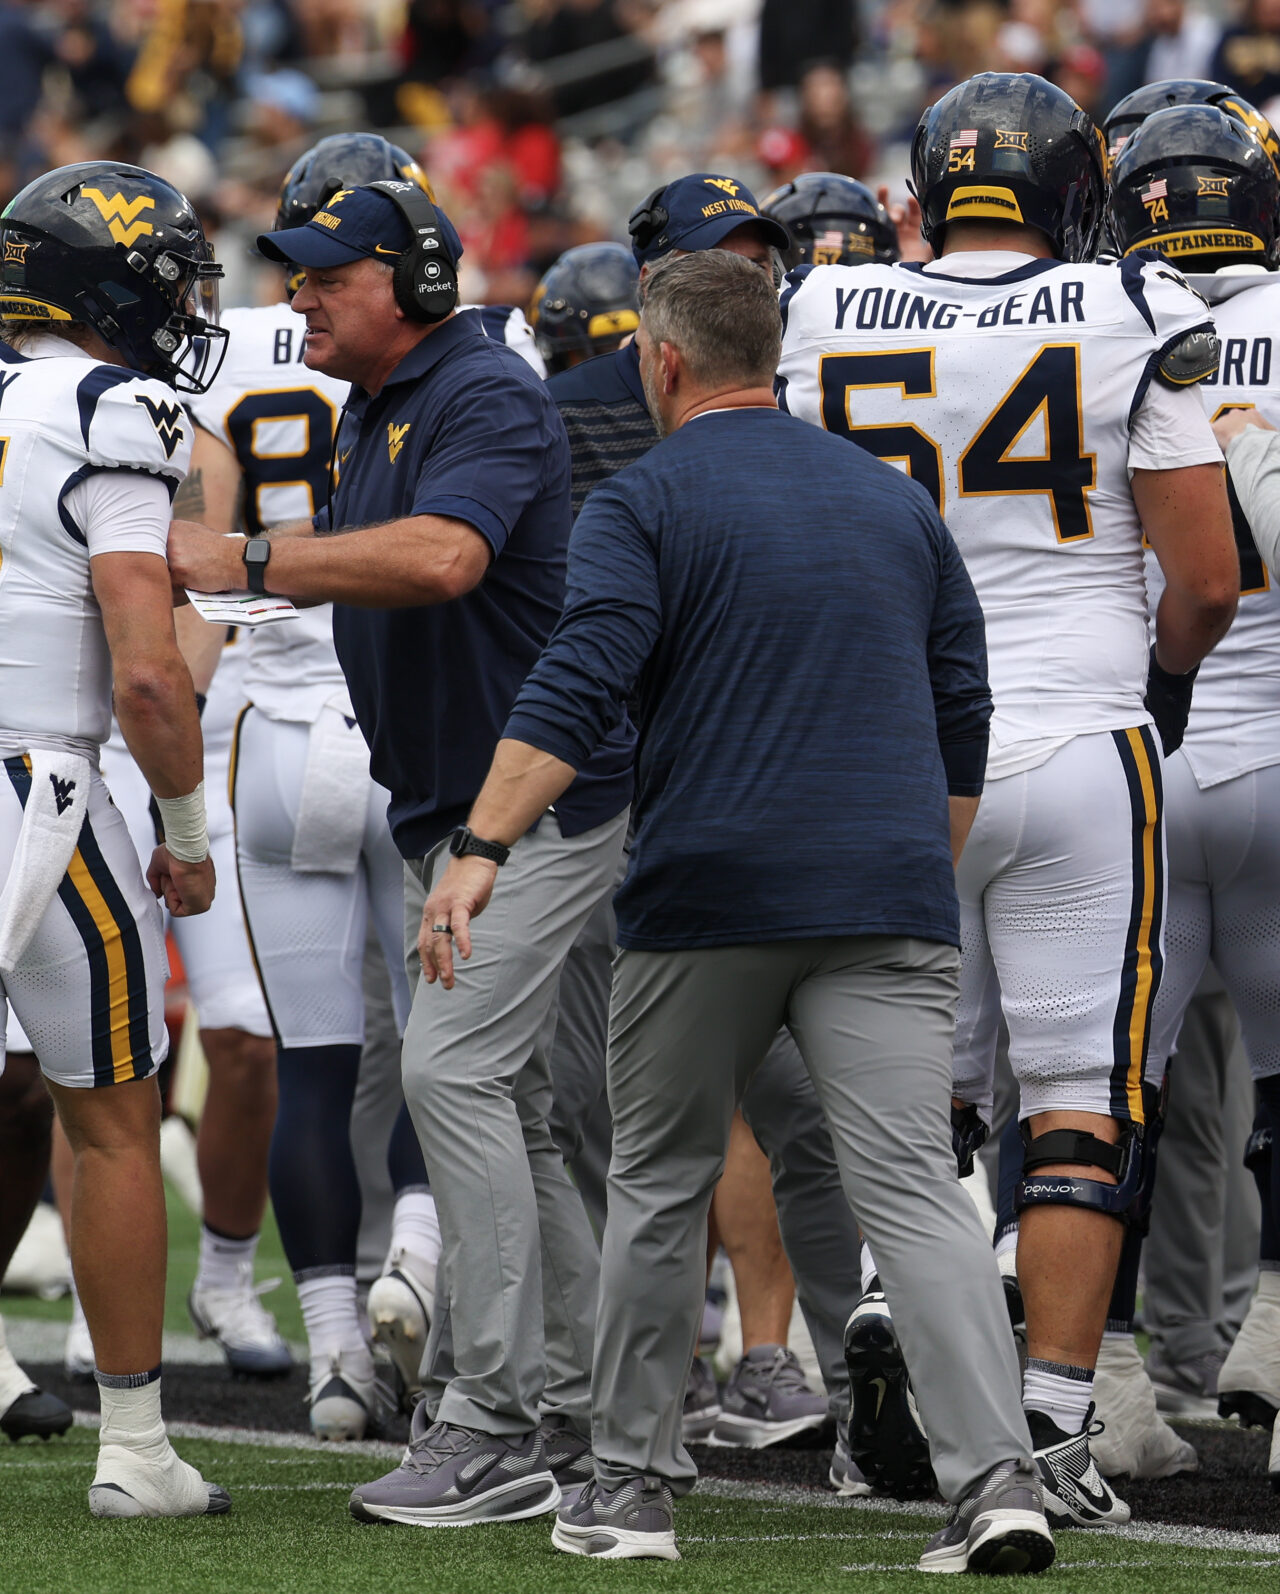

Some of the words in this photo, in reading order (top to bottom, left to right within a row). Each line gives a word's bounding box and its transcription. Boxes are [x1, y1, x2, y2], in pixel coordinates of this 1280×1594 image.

[949, 148, 976, 172] 54
[701, 200, 727, 218] WEST
[1144, 198, 1169, 224] 74
[418, 281, 452, 294] iPacket
[834, 281, 1086, 330] YOUNG-BEAR
[818, 342, 1097, 544] 54
[1024, 1184, 1081, 1194] DONJOY
[1056, 1486, 1085, 1514] FORCE
